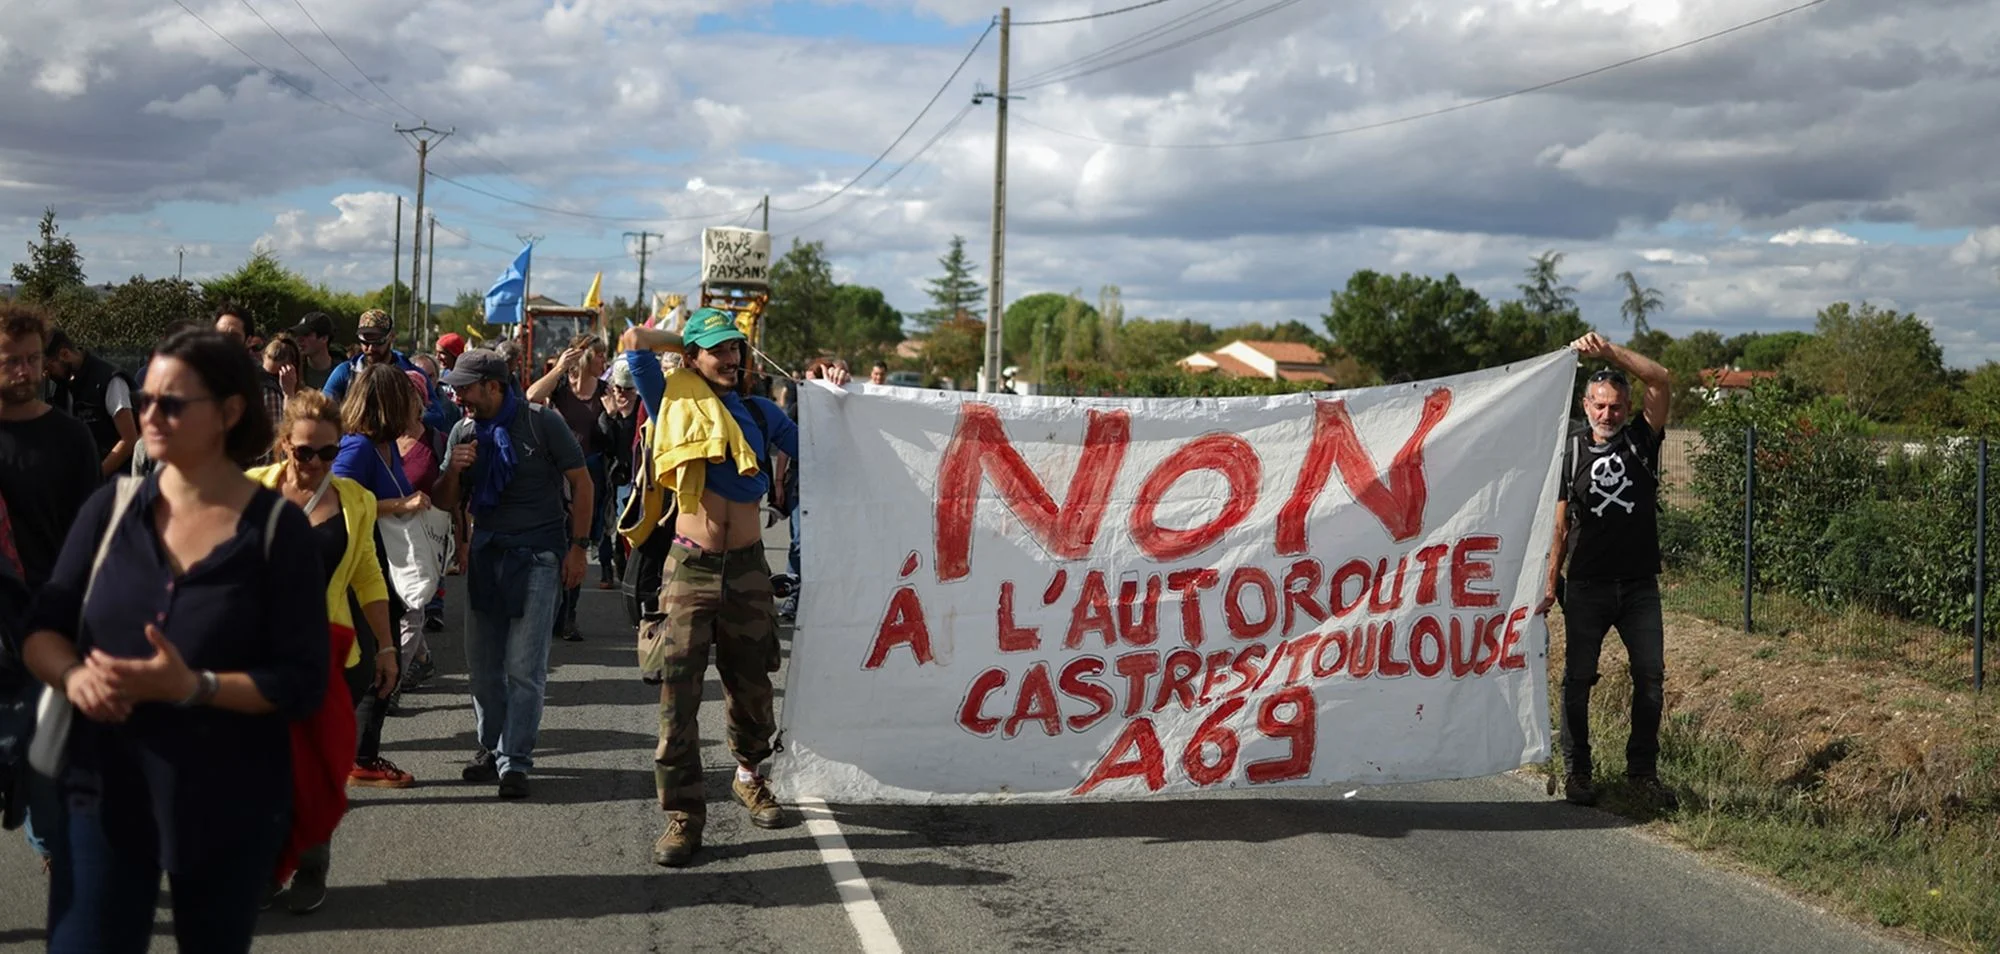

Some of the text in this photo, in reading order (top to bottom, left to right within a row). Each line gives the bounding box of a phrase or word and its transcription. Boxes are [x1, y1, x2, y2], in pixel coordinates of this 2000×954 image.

[714, 231, 752, 241] PAS DE
[716, 241, 752, 257] PAYS
[716, 255, 747, 266] SANS
[709, 264, 767, 279] PAYSANS
[935, 387, 1452, 582] NON
[998, 535, 1501, 652] L'AUTOROUTE
[960, 606, 1528, 736] CASTRES/TOULOUSE
[1073, 685, 1316, 795] A69
